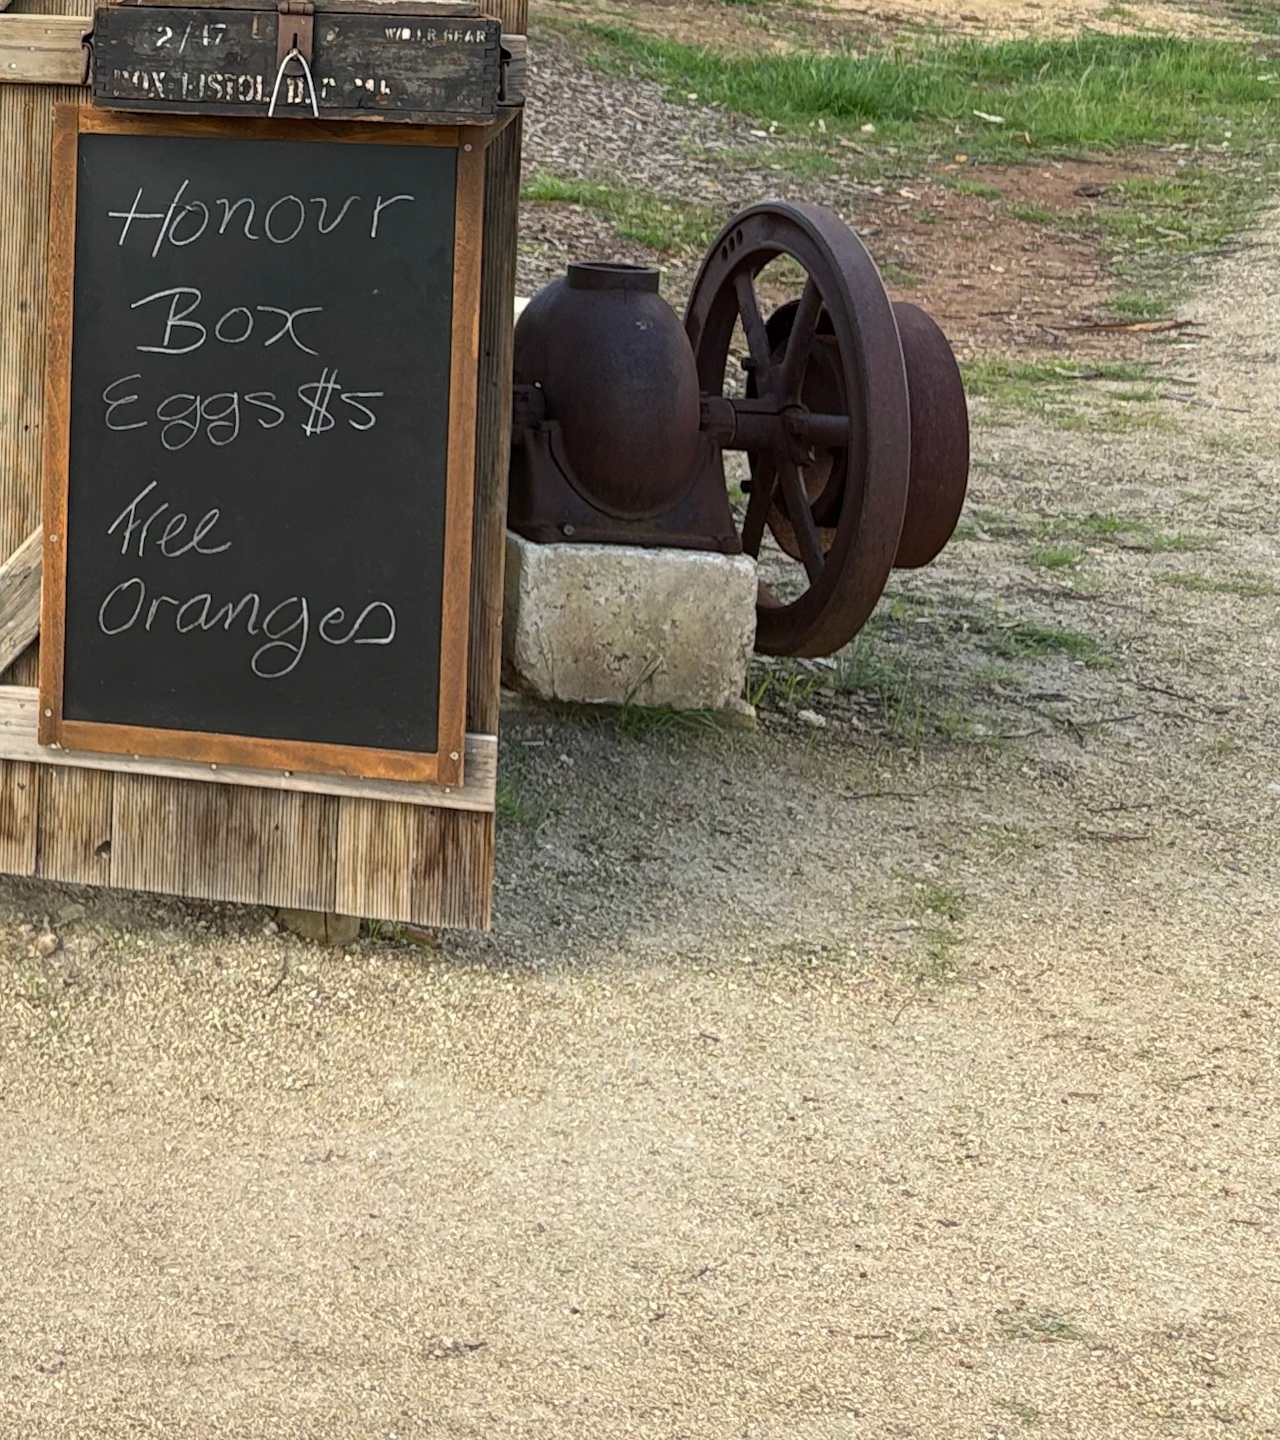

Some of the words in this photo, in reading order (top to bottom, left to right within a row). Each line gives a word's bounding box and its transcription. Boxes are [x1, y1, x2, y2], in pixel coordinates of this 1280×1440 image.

[102, 374, 285, 450] Eggs
[297, 368, 384, 436] $5
[108, 480, 232, 557] Free
[98, 577, 397, 678] Oranges
